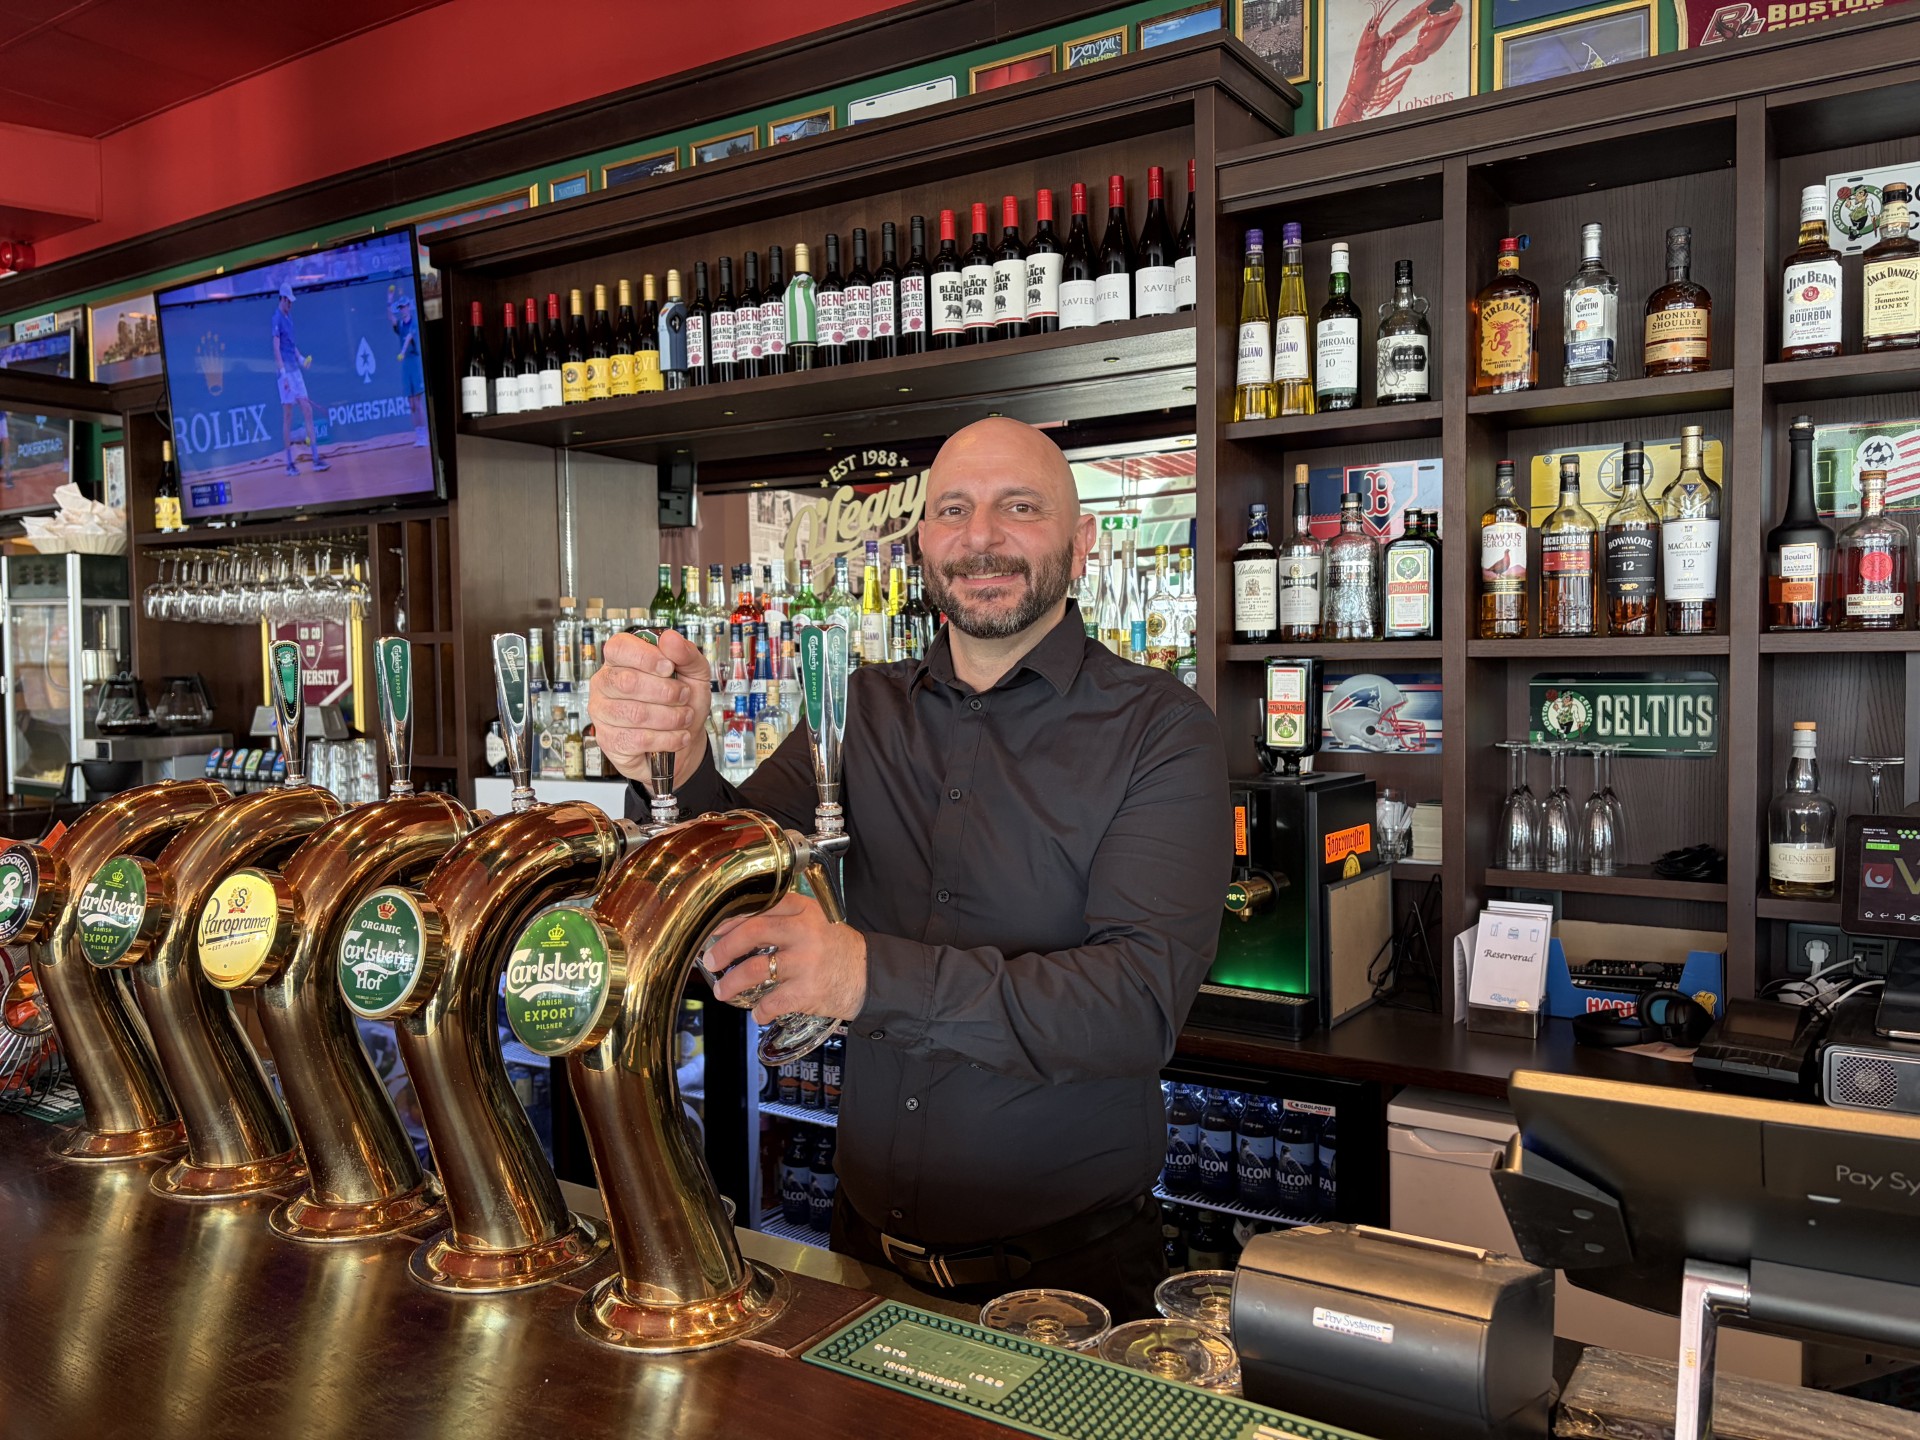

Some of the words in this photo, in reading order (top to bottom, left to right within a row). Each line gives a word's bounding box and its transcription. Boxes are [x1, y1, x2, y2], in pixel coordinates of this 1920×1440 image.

[1768, 0, 1885, 24] BOSTO
[1397, 91, 1454, 113] Lobsters
[1832, 200, 1846, 231] BOSTON
[1026, 267, 1046, 278] LACK
[1867, 270, 1887, 287] JACK
[1887, 266, 1919, 281] DANIEL'S
[902, 278, 923, 294] BENE
[963, 278, 988, 289] BLACK
[994, 282, 1009, 293] EAR
[1786, 274, 1806, 295] JIM
[1807, 270, 1837, 290] BEAM
[847, 288, 870, 302] BENE
[911, 293, 923, 301] RED
[964, 287, 985, 297] BEAR
[859, 302, 870, 310] RED
[880, 298, 892, 306] RED
[1061, 296, 1096, 308] XAVIER
[1874, 296, 1910, 304] Tennessee
[762, 304, 784, 318] BENE
[1483, 301, 1527, 321] FIREBALL
[1575, 301, 1599, 313] Cuervo
[1874, 302, 1910, 311] HONEY
[773, 318, 784, 326] RED
[1656, 310, 1699, 322] MONKEY
[1789, 309, 1832, 324] BOURBON
[1651, 318, 1702, 331] SHOULDER
[1325, 358, 1336, 368] 10
[828, 454, 857, 481] EST
[862, 449, 898, 467] 1988
[1486, 532, 1522, 541] FAMOUS
[1542, 534, 1591, 546] AUCHENTOSHAN
[1486, 540, 1522, 549] GROUSE
[1608, 536, 1653, 550] BOWMORE
[1667, 541, 1712, 551] MACALLAN
[1783, 553, 1812, 561] Boulard
[1622, 560, 1635, 571] 12
[1682, 558, 1695, 569] 12
[1291, 589, 1301, 599] 21
[1894, 595, 1903, 607] 8
[808, 635, 819, 671] Carlsberg
[1541, 700, 1553, 732] BOSTON
[1578, 695, 1594, 727] CELTICS
[1596, 694, 1713, 738] CELTICS
[1326, 829, 1366, 859] Jägermeister
[1778, 852, 1832, 864] GLENKINCHIE
[78, 883, 145, 924] Carlsberg
[198, 897, 272, 948] Staropramen
[361, 919, 402, 935] ORGANIC
[84, 933, 120, 945] EXPORT
[229, 937, 251, 948] PRAGUE
[342, 930, 415, 973] Carlsberg
[1484, 948, 1536, 963] Reserverad
[507, 947, 604, 994] Carlsberg
[355, 970, 390, 991] Hof
[536, 998, 563, 1007] DANISH
[524, 1006, 576, 1023] EXPORT
[535, 1021, 563, 1030] PILSNER
[1300, 1103, 1332, 1112] COOLPOINT
[1836, 1164, 1883, 1191] Pay
[1325, 1310, 1342, 1325] Pay
[1343, 1314, 1381, 1334] Systems
[883, 1359, 916, 1376] IRISH
[916, 1369, 968, 1391] WHISKEY
